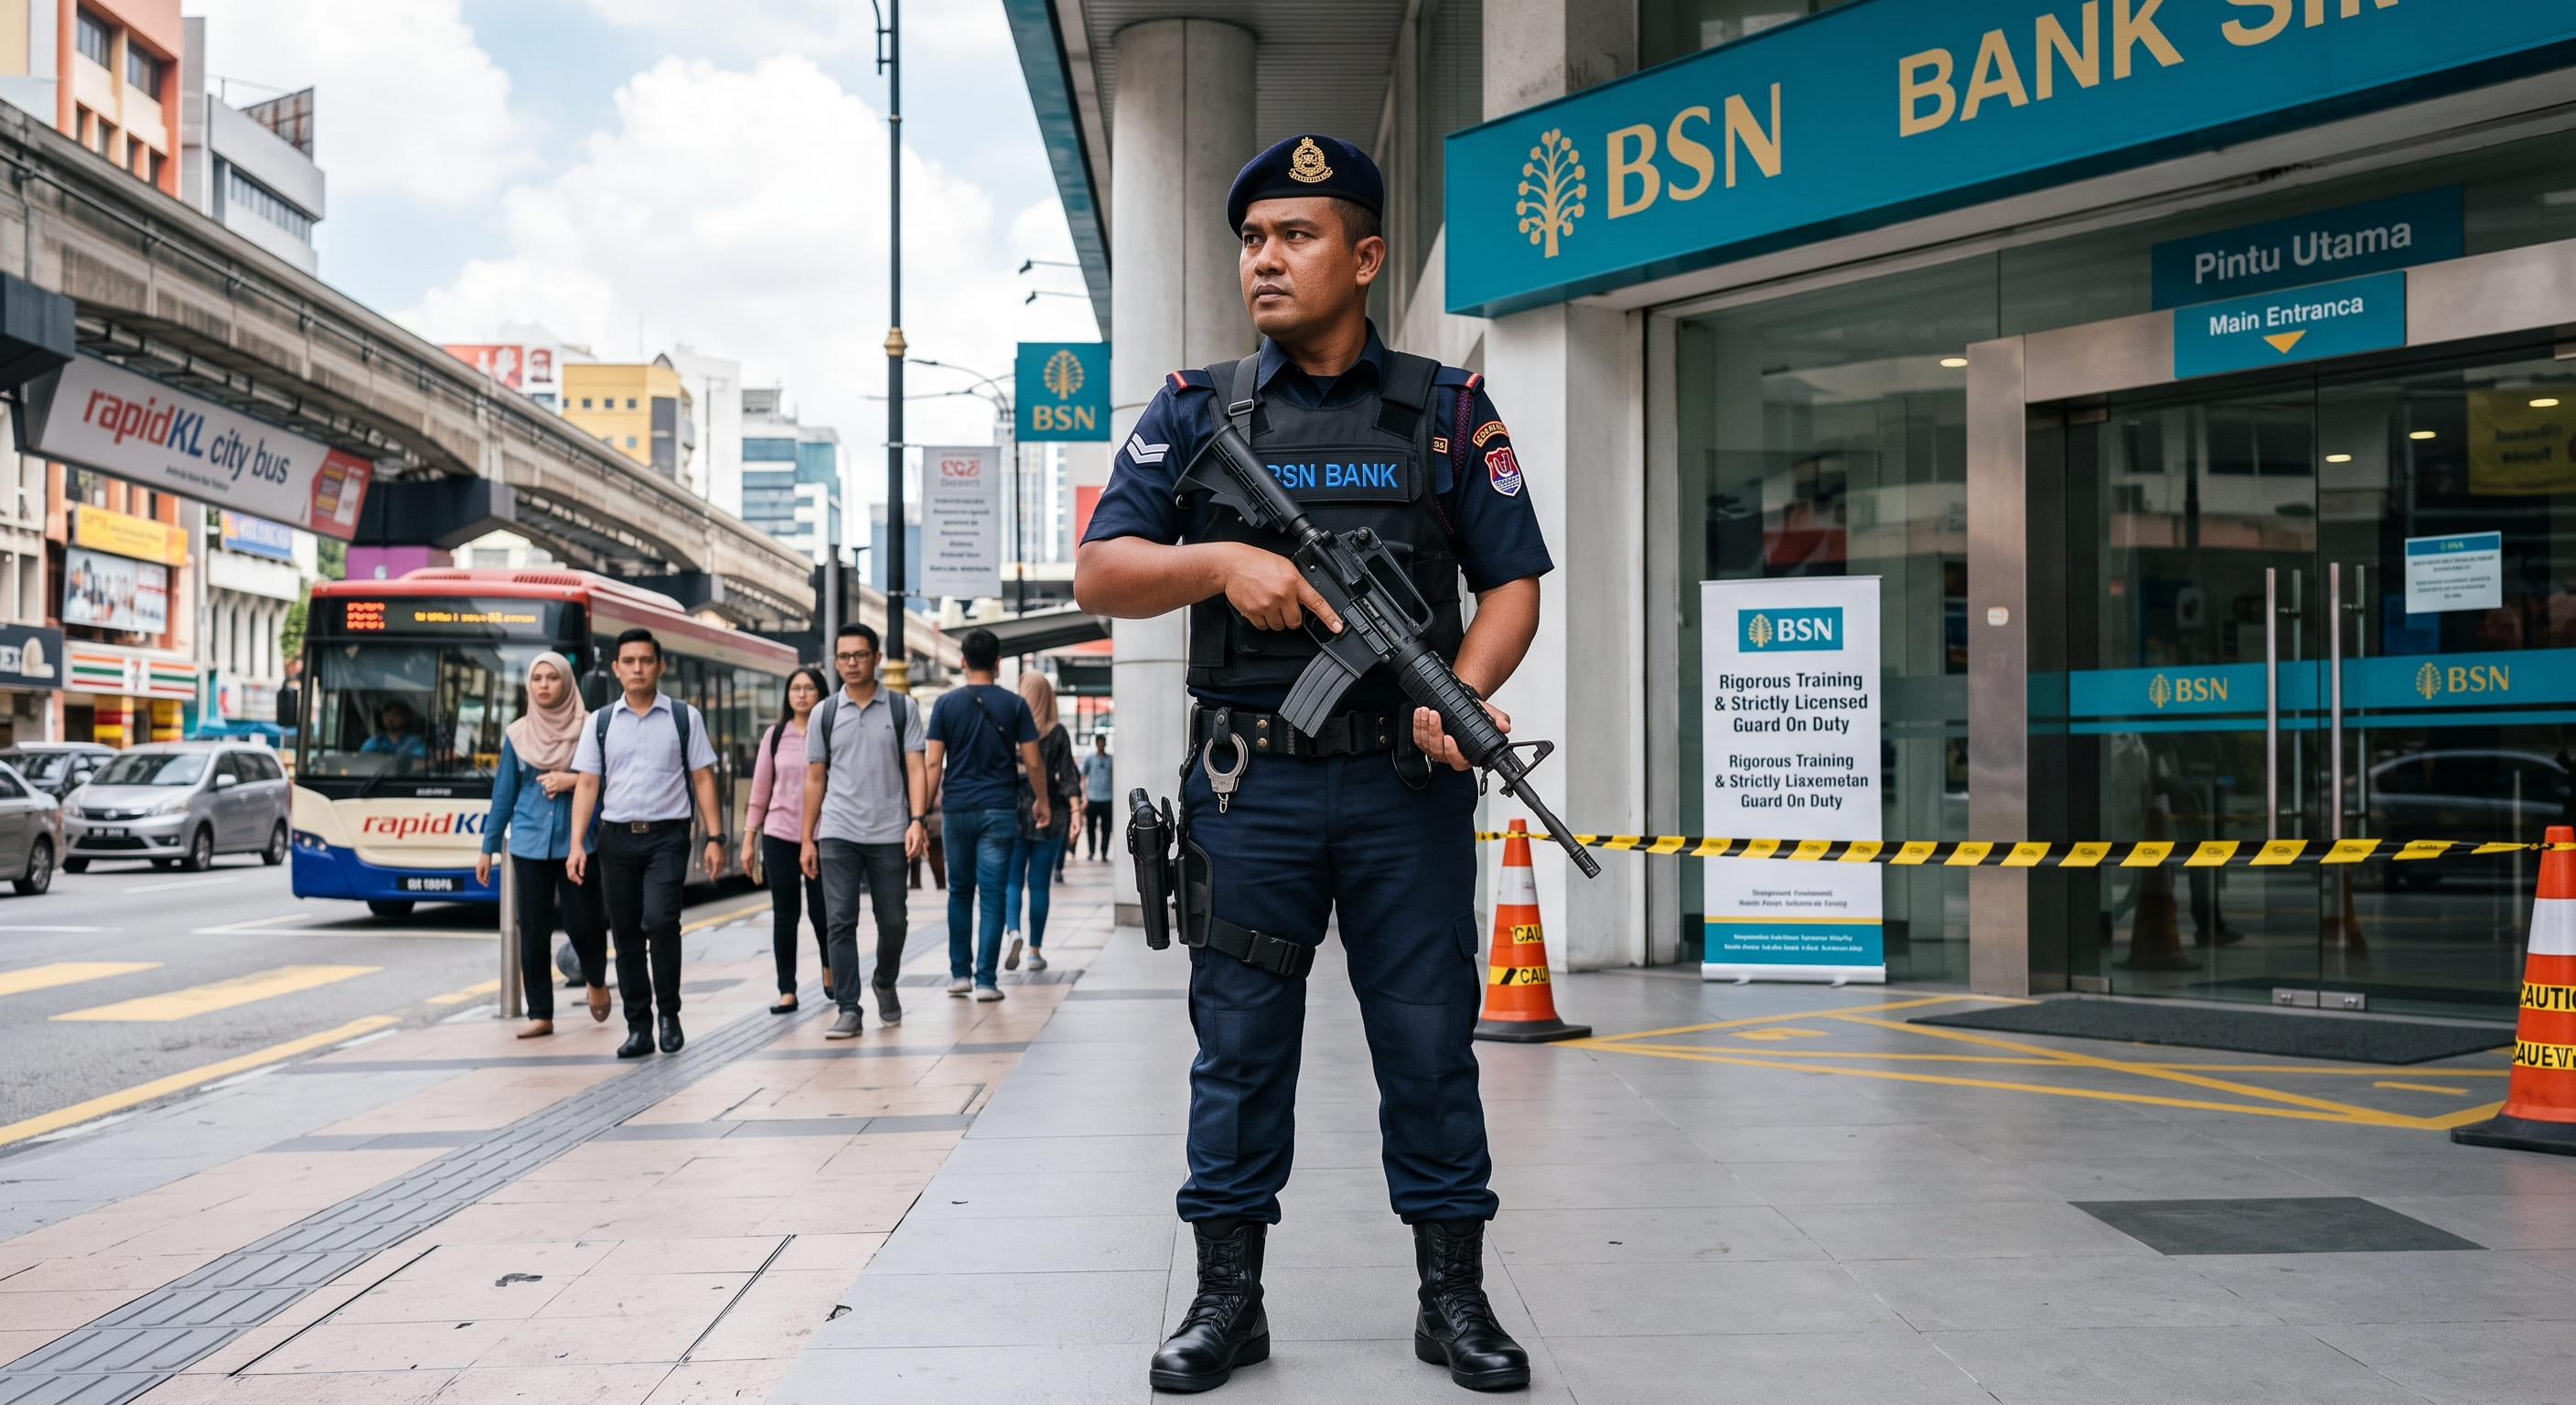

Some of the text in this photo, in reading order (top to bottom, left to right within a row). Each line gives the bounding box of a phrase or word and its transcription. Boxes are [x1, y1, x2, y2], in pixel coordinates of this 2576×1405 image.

[1606, 0, 2185, 220] BSN BANK
[2195, 222, 2412, 284] Pintu Utama
[2209, 312, 2259, 336] Main
[1032, 404, 1096, 431] BSN
[81, 388, 206, 459] rapidKL
[209, 428, 252, 481] city
[252, 438, 291, 485] bus
[1326, 463, 1399, 488] BANK
[1776, 617, 1833, 642] BSN
[1719, 672, 1863, 692] Rigorous Training
[2175, 677, 2228, 702] BSN
[2447, 665, 2510, 693] BSN
[1714, 694, 1868, 713] & Strictly Licensed
[1733, 716, 1850, 734] Guard On Duty
[1729, 754, 1854, 770] Rigorous Training
[1715, 775, 1725, 788] &
[1730, 774, 1781, 791] Strictly
[1741, 794, 1843, 810] Guard On Duty
